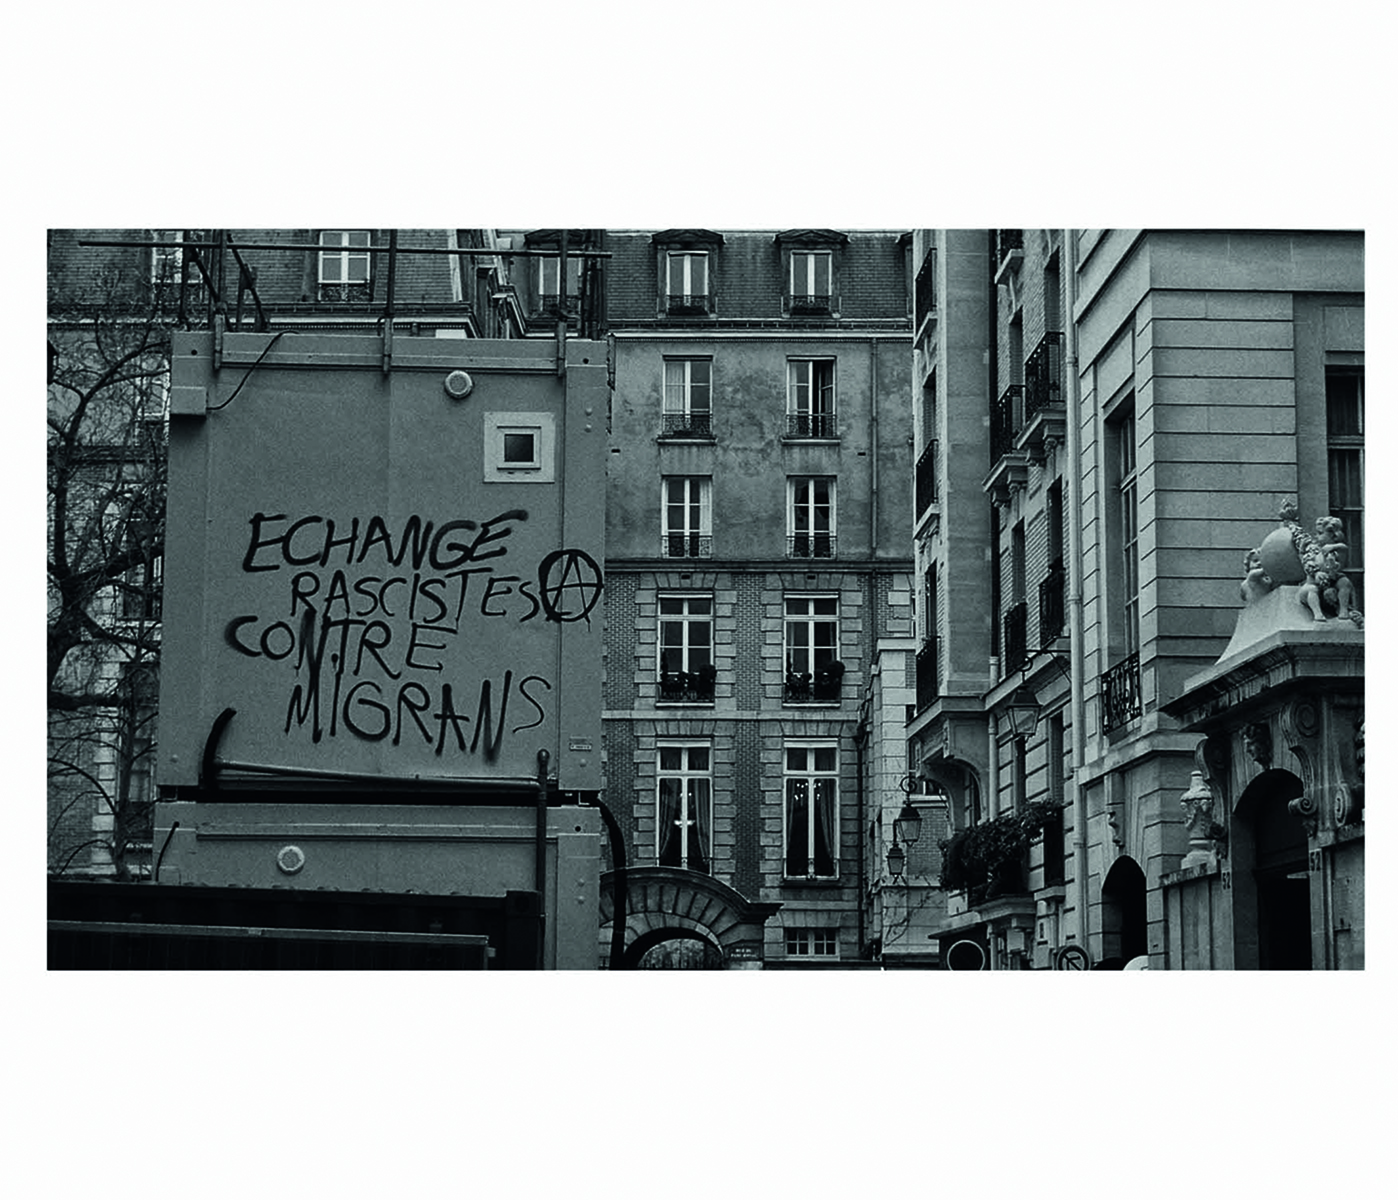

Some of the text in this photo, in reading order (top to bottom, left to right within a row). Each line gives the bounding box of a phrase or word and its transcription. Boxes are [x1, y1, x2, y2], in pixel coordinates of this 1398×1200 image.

[242, 509, 529, 572] ECHANGE
[290, 566, 540, 626] RASCISTES
[224, 609, 458, 680] CONTRE
[284, 669, 552, 764] MIGRANS
